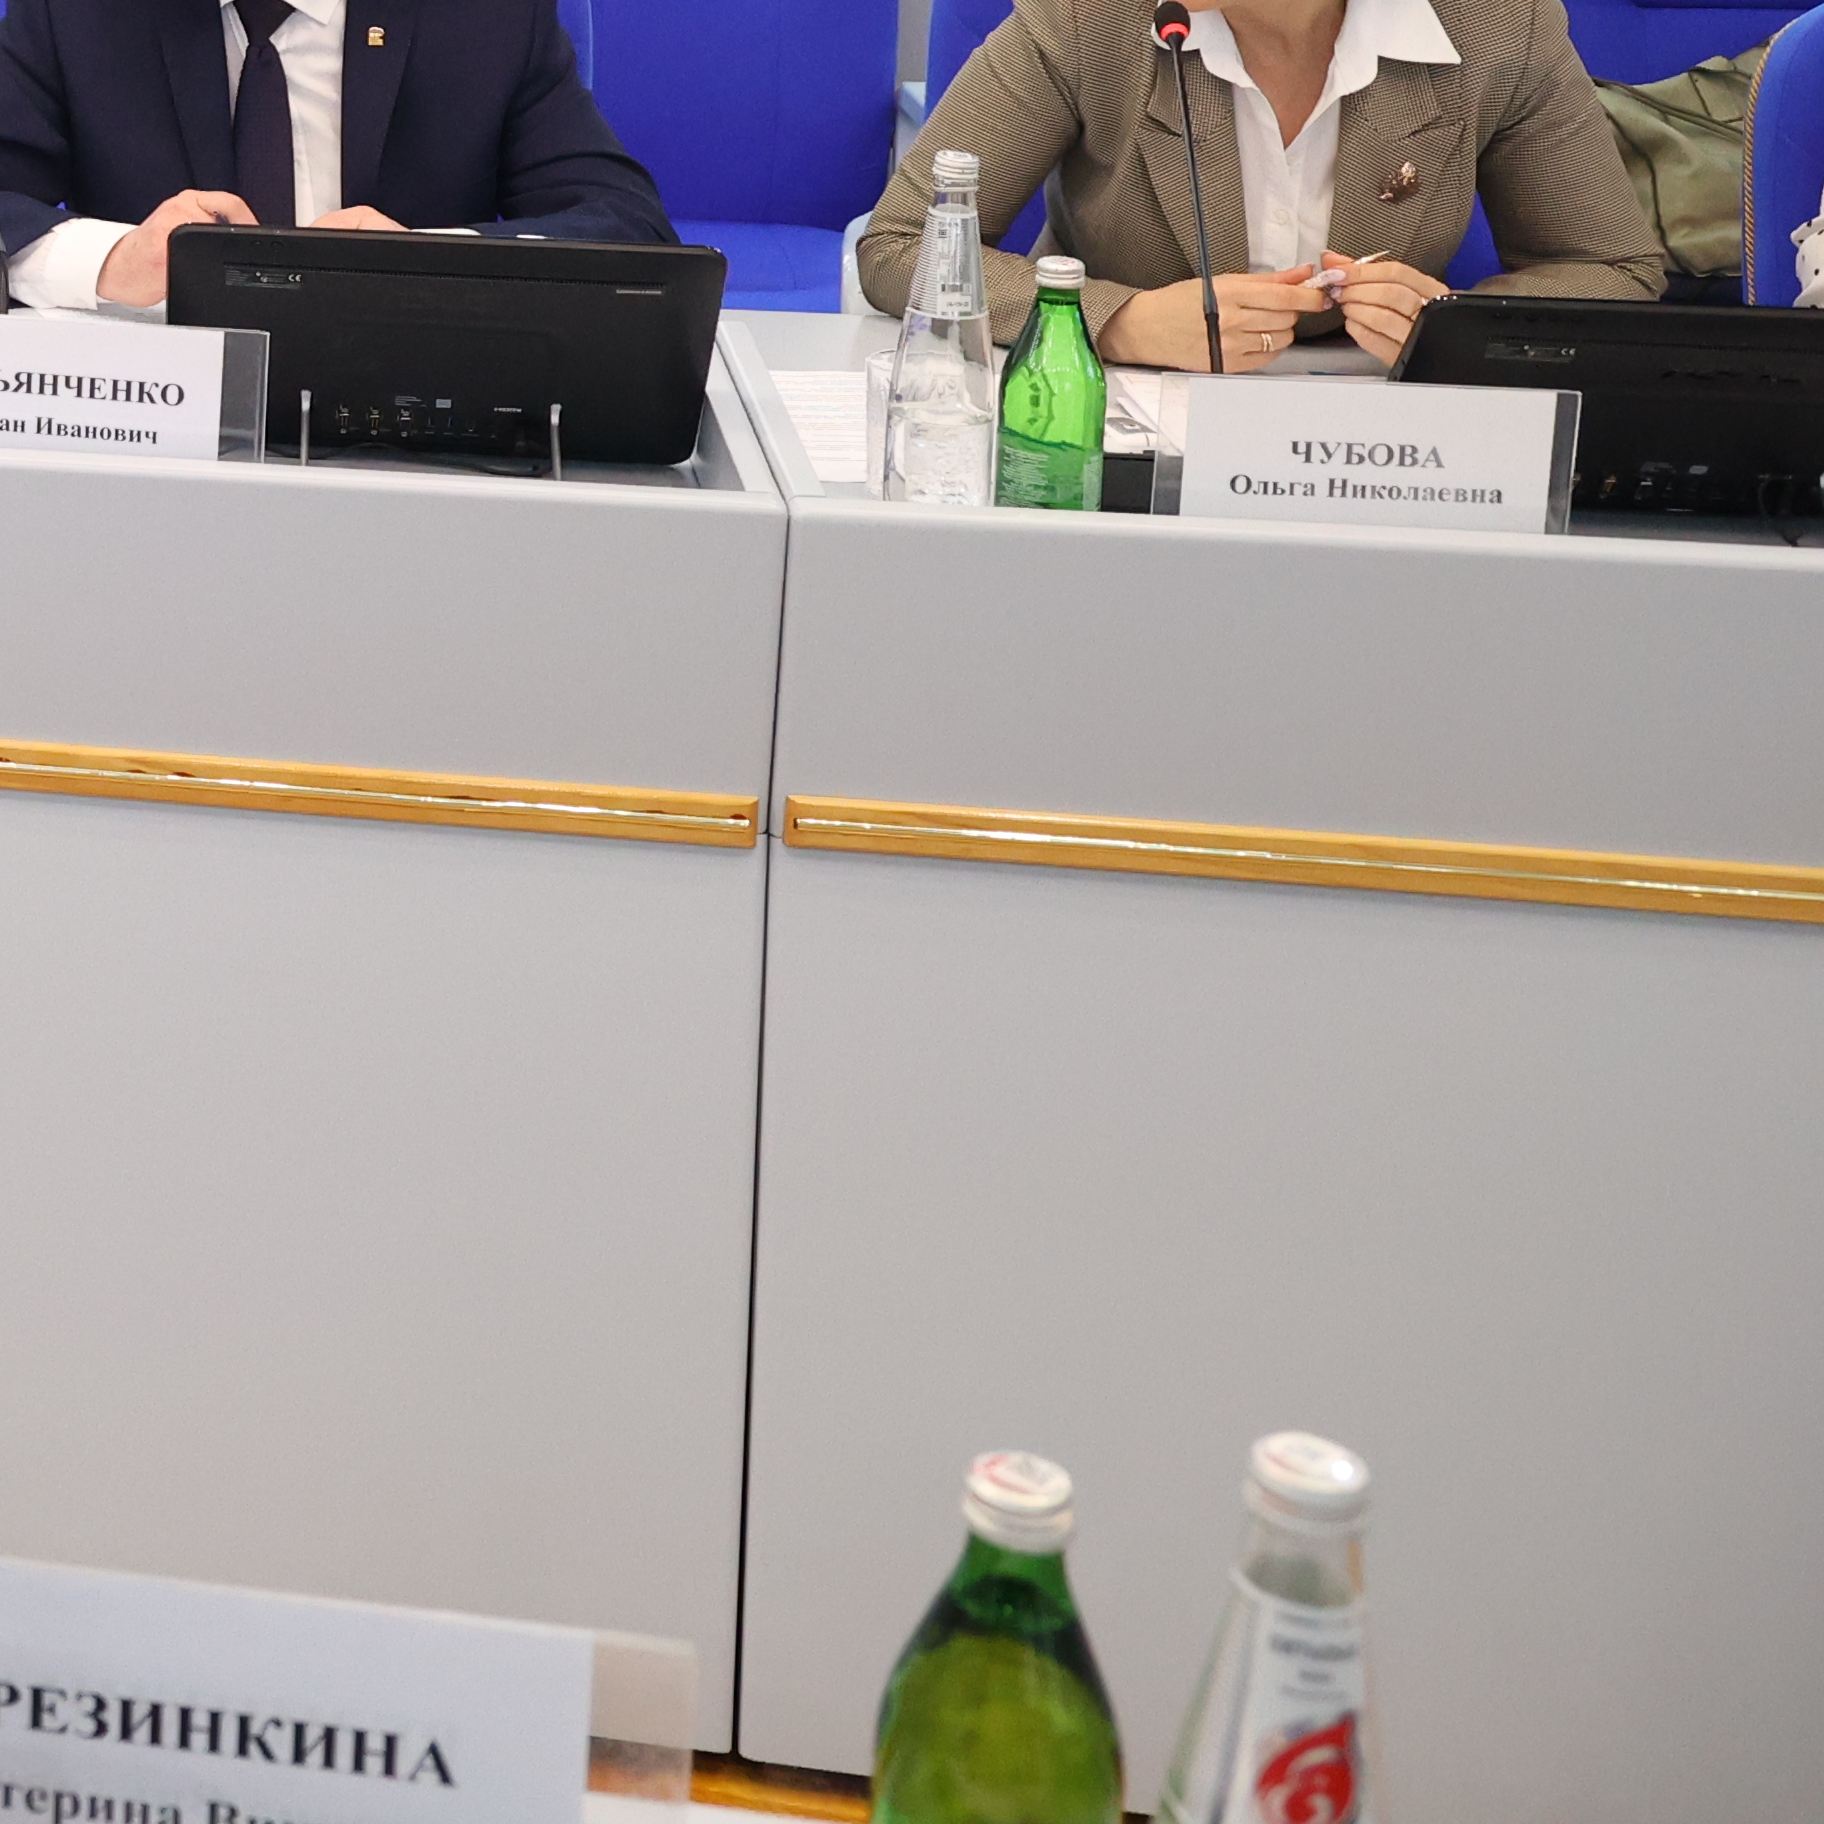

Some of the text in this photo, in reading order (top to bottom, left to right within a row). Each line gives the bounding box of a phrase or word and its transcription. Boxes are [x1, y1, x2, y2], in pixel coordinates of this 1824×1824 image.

[35, 416, 158, 444] Иванович
[1290, 440, 1445, 469] ЧУБОВА
[1230, 474, 1503, 504] Ольга Николаевна
